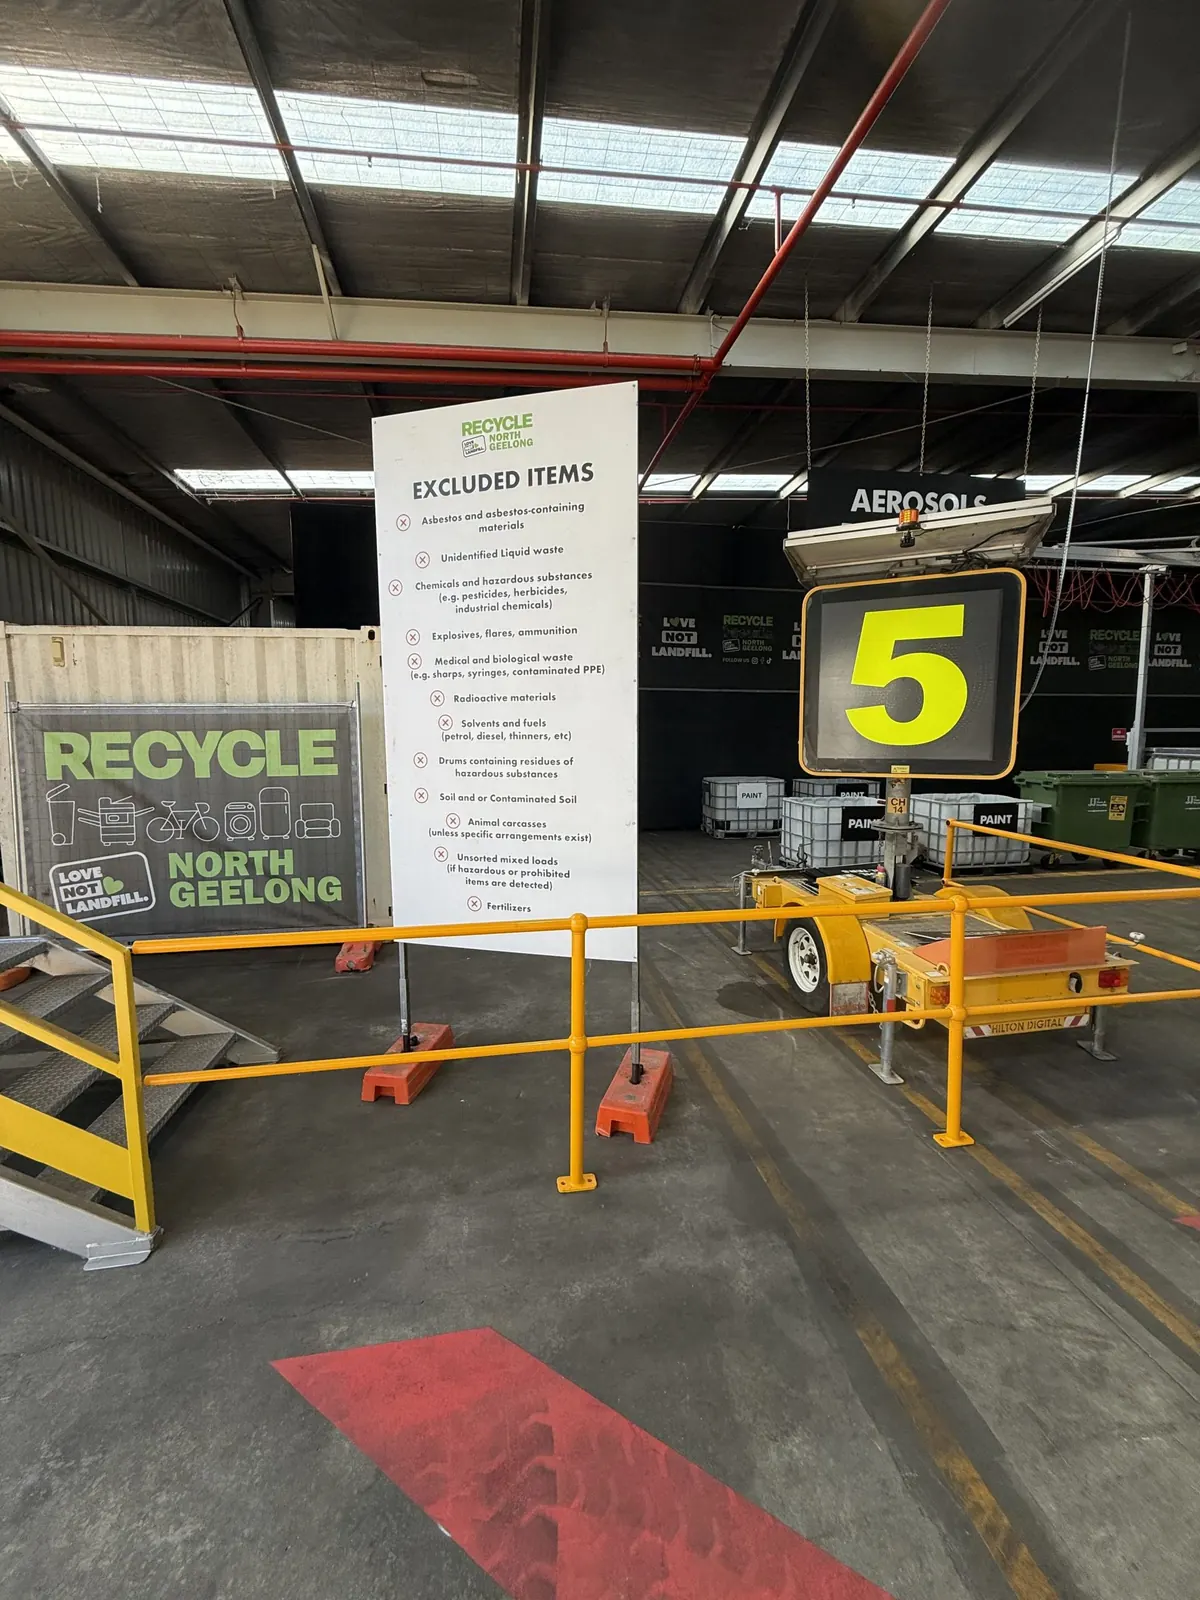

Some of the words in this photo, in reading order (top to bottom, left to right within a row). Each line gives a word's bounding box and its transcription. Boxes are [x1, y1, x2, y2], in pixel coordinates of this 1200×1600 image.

[462, 413, 532, 436] RECYCLE
[490, 431, 520, 442] NORTH
[490, 438, 533, 450] GEELONG
[413, 470, 520, 500] EXCLUDED
[528, 462, 594, 486] ITEMS
[422, 515, 462, 526] Asbestos
[464, 510, 483, 520] and
[486, 502, 584, 518] asbestos-containing
[479, 520, 524, 532] materials
[441, 549, 498, 562] Unidentified
[501, 546, 530, 559] Liquid
[533, 546, 564, 555] waste
[415, 579, 460, 590] Chemicals
[462, 577, 479, 587] and
[483, 574, 534, 585] hazardous
[537, 572, 592, 582] substances
[439, 593, 460, 603] (e.g.
[462, 589, 510, 602] pesticides,
[514, 586, 567, 596] herbicides,
[456, 602, 499, 613] industrial
[502, 599, 552, 610] chemicals)
[723, 615, 773, 626] RECYCLE
[432, 631, 482, 642] Explosives,
[485, 629, 515, 637] flares,
[518, 626, 577, 636] ammunition
[665, 632, 693, 642] NOT
[1090, 630, 1140, 641] RECYCLE
[652, 646, 712, 658] LANDFILL.
[1158, 646, 1178, 654] NOT
[435, 656, 469, 665] Medical
[472, 655, 490, 664] and
[493, 653, 539, 665] biological
[543, 654, 573, 662] waste
[410, 671, 430, 681] (e.g.
[433, 670, 464, 680] sharps,
[468, 668, 509, 679] syringes,
[512, 665, 580, 675] contaminated
[584, 664, 605, 675] PPE)
[845, 604, 968, 746] 5
[454, 693, 508, 702] Radioactive
[511, 692, 556, 701] materials
[462, 719, 500, 728] Solvents
[502, 719, 520, 728] and
[523, 718, 546, 727] fuels
[441, 732, 474, 742] (petrol,
[477, 732, 506, 741] diesel,
[509, 731, 551, 741] thinners,
[554, 731, 571, 741] etc)
[44, 729, 338, 780] RECYCLE
[439, 757, 467, 765] Drums
[470, 757, 517, 767] containing
[520, 757, 560, 765] residues
[563, 757, 573, 765] of
[455, 769, 503, 777] hazardous
[506, 769, 558, 778] substances
[440, 793, 456, 801] Soil
[458, 794, 475, 802] and
[490, 794, 556, 803] Contaminated
[559, 795, 576, 803] Soil
[891, 798, 906, 806] CH
[893, 806, 903, 814] 14
[468, 818, 499, 826] Animal
[848, 818, 879, 828] PAIN
[980, 815, 1012, 825] PAINT
[429, 828, 459, 838] (unless
[461, 830, 493, 839] specific
[496, 833, 562, 842] arrangements
[565, 833, 591, 843] exist)
[168, 849, 294, 879] NORTH
[457, 853, 497, 862] Unsorted
[500, 856, 529, 864] mixed
[532, 856, 558, 865] loads
[58, 866, 103, 882] LOVE
[447, 864, 457, 873] (if
[458, 865, 506, 875] hazardous
[520, 869, 570, 878] prohibited
[466, 877, 489, 886] items
[509, 879, 552, 891] detected)
[64, 884, 99, 898] NOT
[170, 876, 342, 908] GEELONG
[66, 892, 149, 914] LANDFILL.
[487, 902, 531, 912] Fertilizers
[992, 1023, 1024, 1034] HILTON
[1027, 1017, 1062, 1030] DIGITAL
